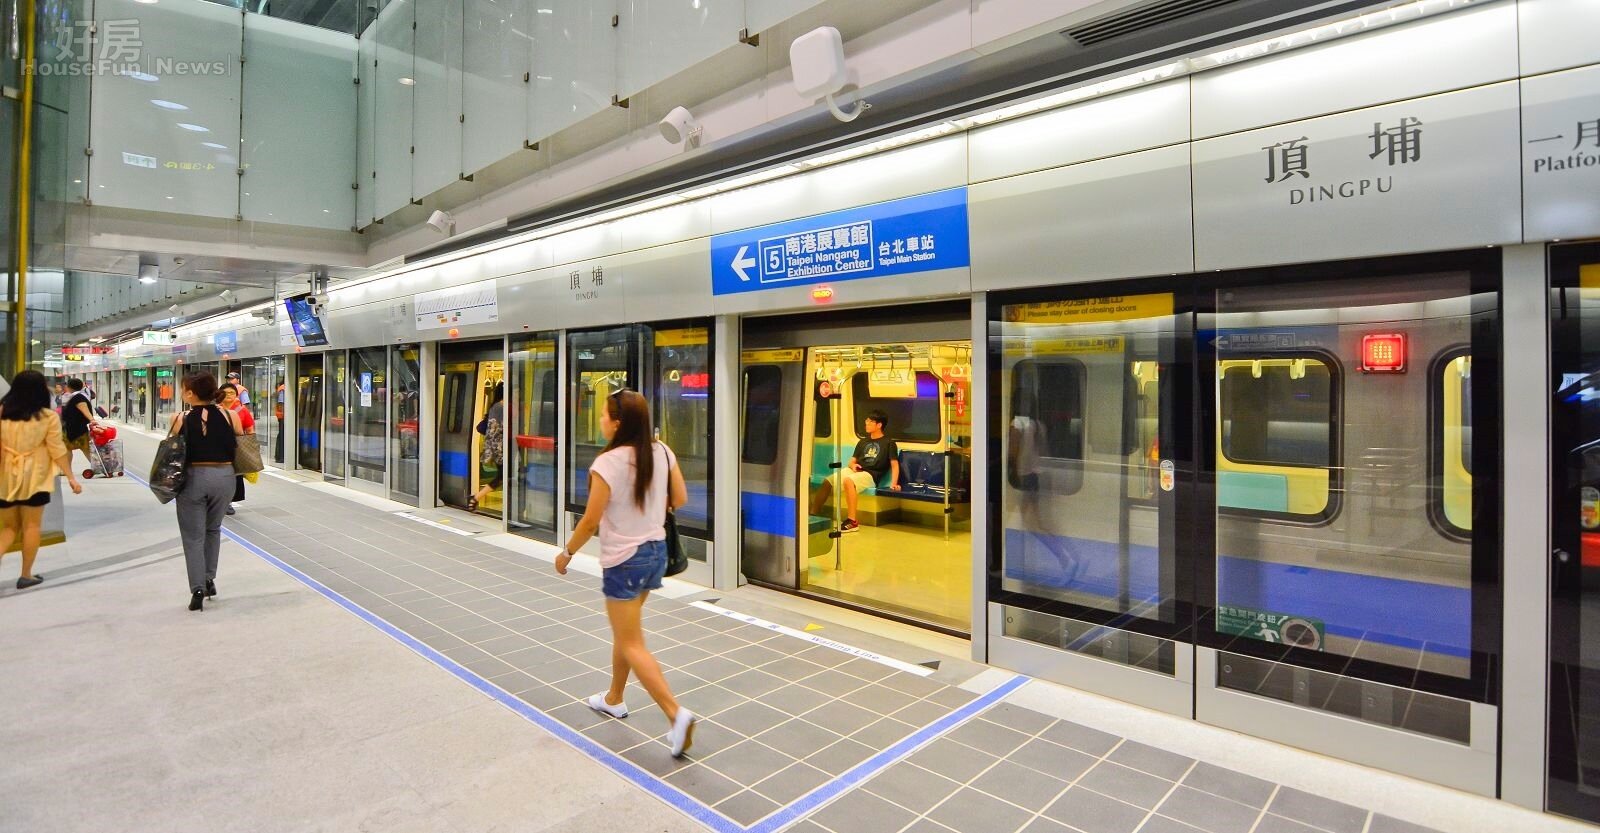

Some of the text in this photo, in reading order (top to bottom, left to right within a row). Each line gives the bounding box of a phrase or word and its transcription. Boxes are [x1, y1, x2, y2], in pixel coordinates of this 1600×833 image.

[1262, 116, 1423, 184] 頂埔
[1534, 151, 1600, 173] Platfo
[1290, 175, 1393, 205] DINGPU
[785, 225, 869, 256] 南港展覽館
[879, 234, 935, 257] 台北車站
[770, 250, 780, 269] 5
[786, 249, 859, 266] Taipei Nangang
[788, 259, 870, 278] Exhibition Center
[879, 252, 936, 267] Taipei Main Station
[569, 265, 603, 290] 頂埔
[1050, 309, 1062, 318] stay
[1064, 308, 1080, 316] clear
[1081, 307, 1088, 315] of
[1089, 305, 1115, 314] closing
[1116, 304, 1137, 312] doors
